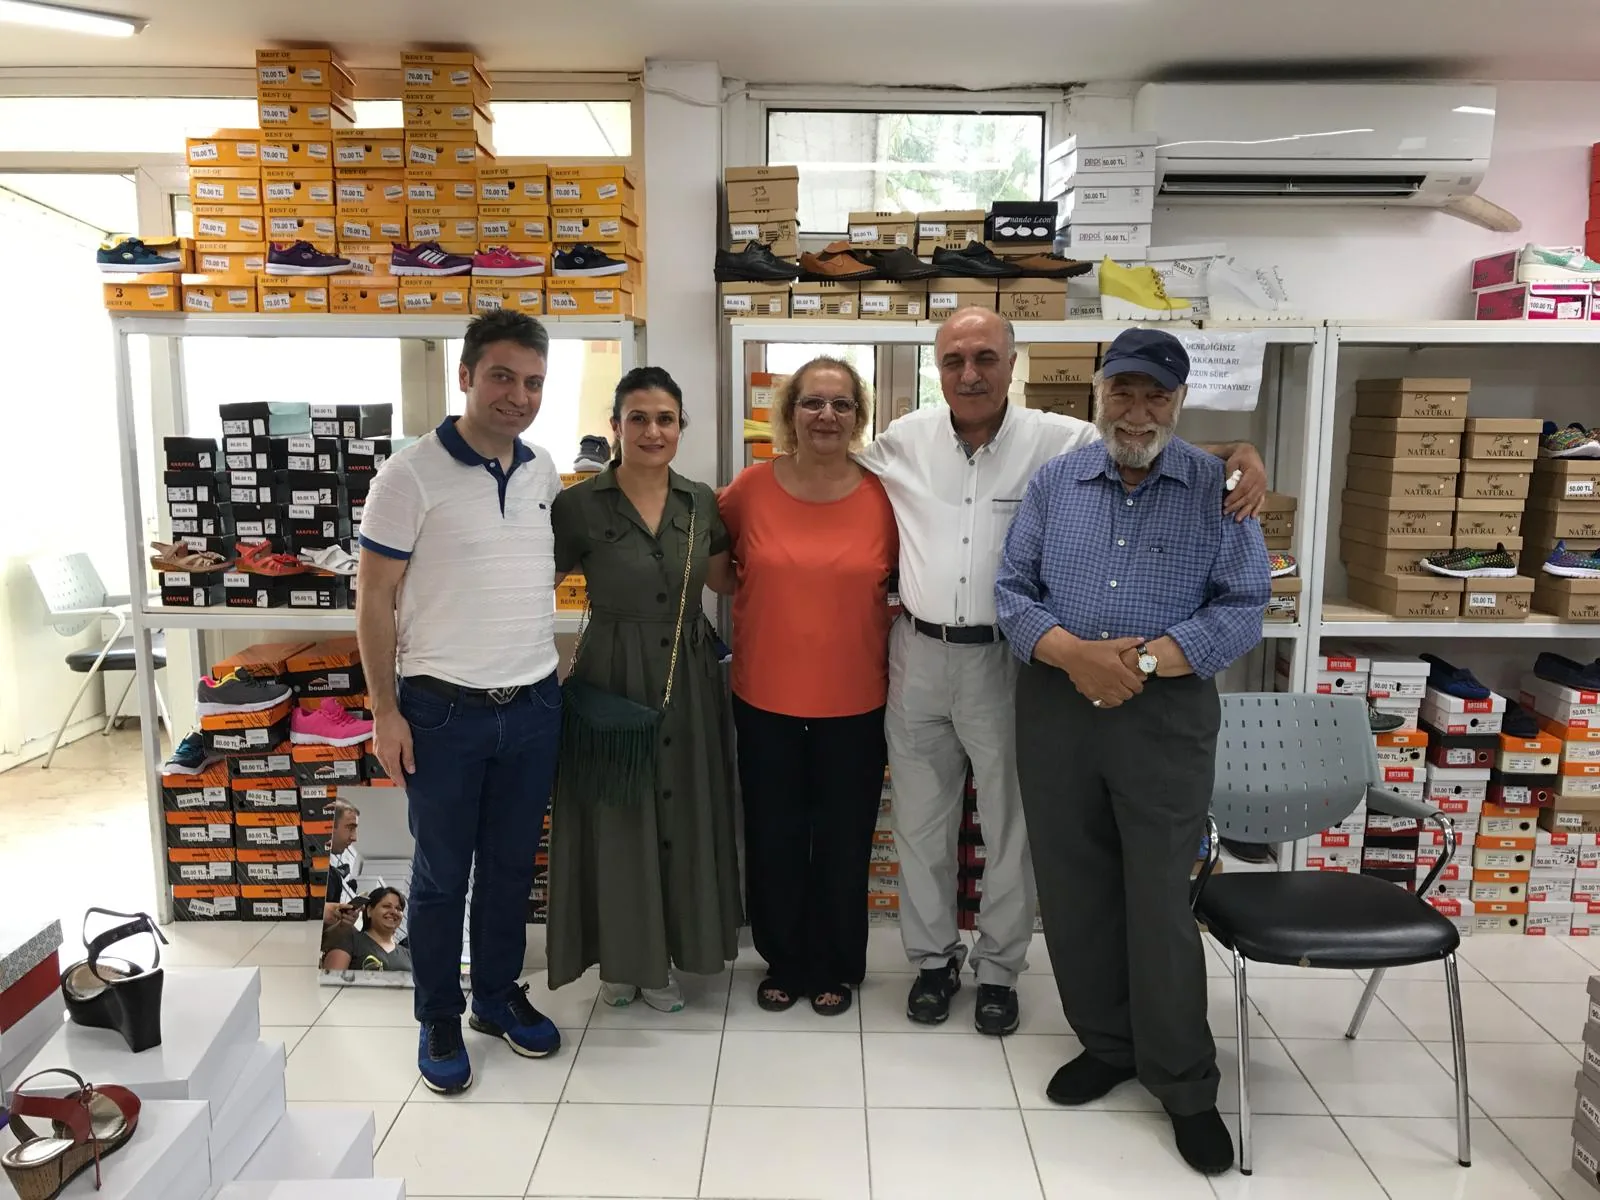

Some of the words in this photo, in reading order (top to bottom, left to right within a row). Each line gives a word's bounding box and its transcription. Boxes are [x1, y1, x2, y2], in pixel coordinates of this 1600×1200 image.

[416, 108, 423, 116] 3
[485, 188, 499, 196] 70.00
[116, 288, 123, 298] 3
[342, 293, 348, 302] 3
[570, 588, 577, 597] 3
